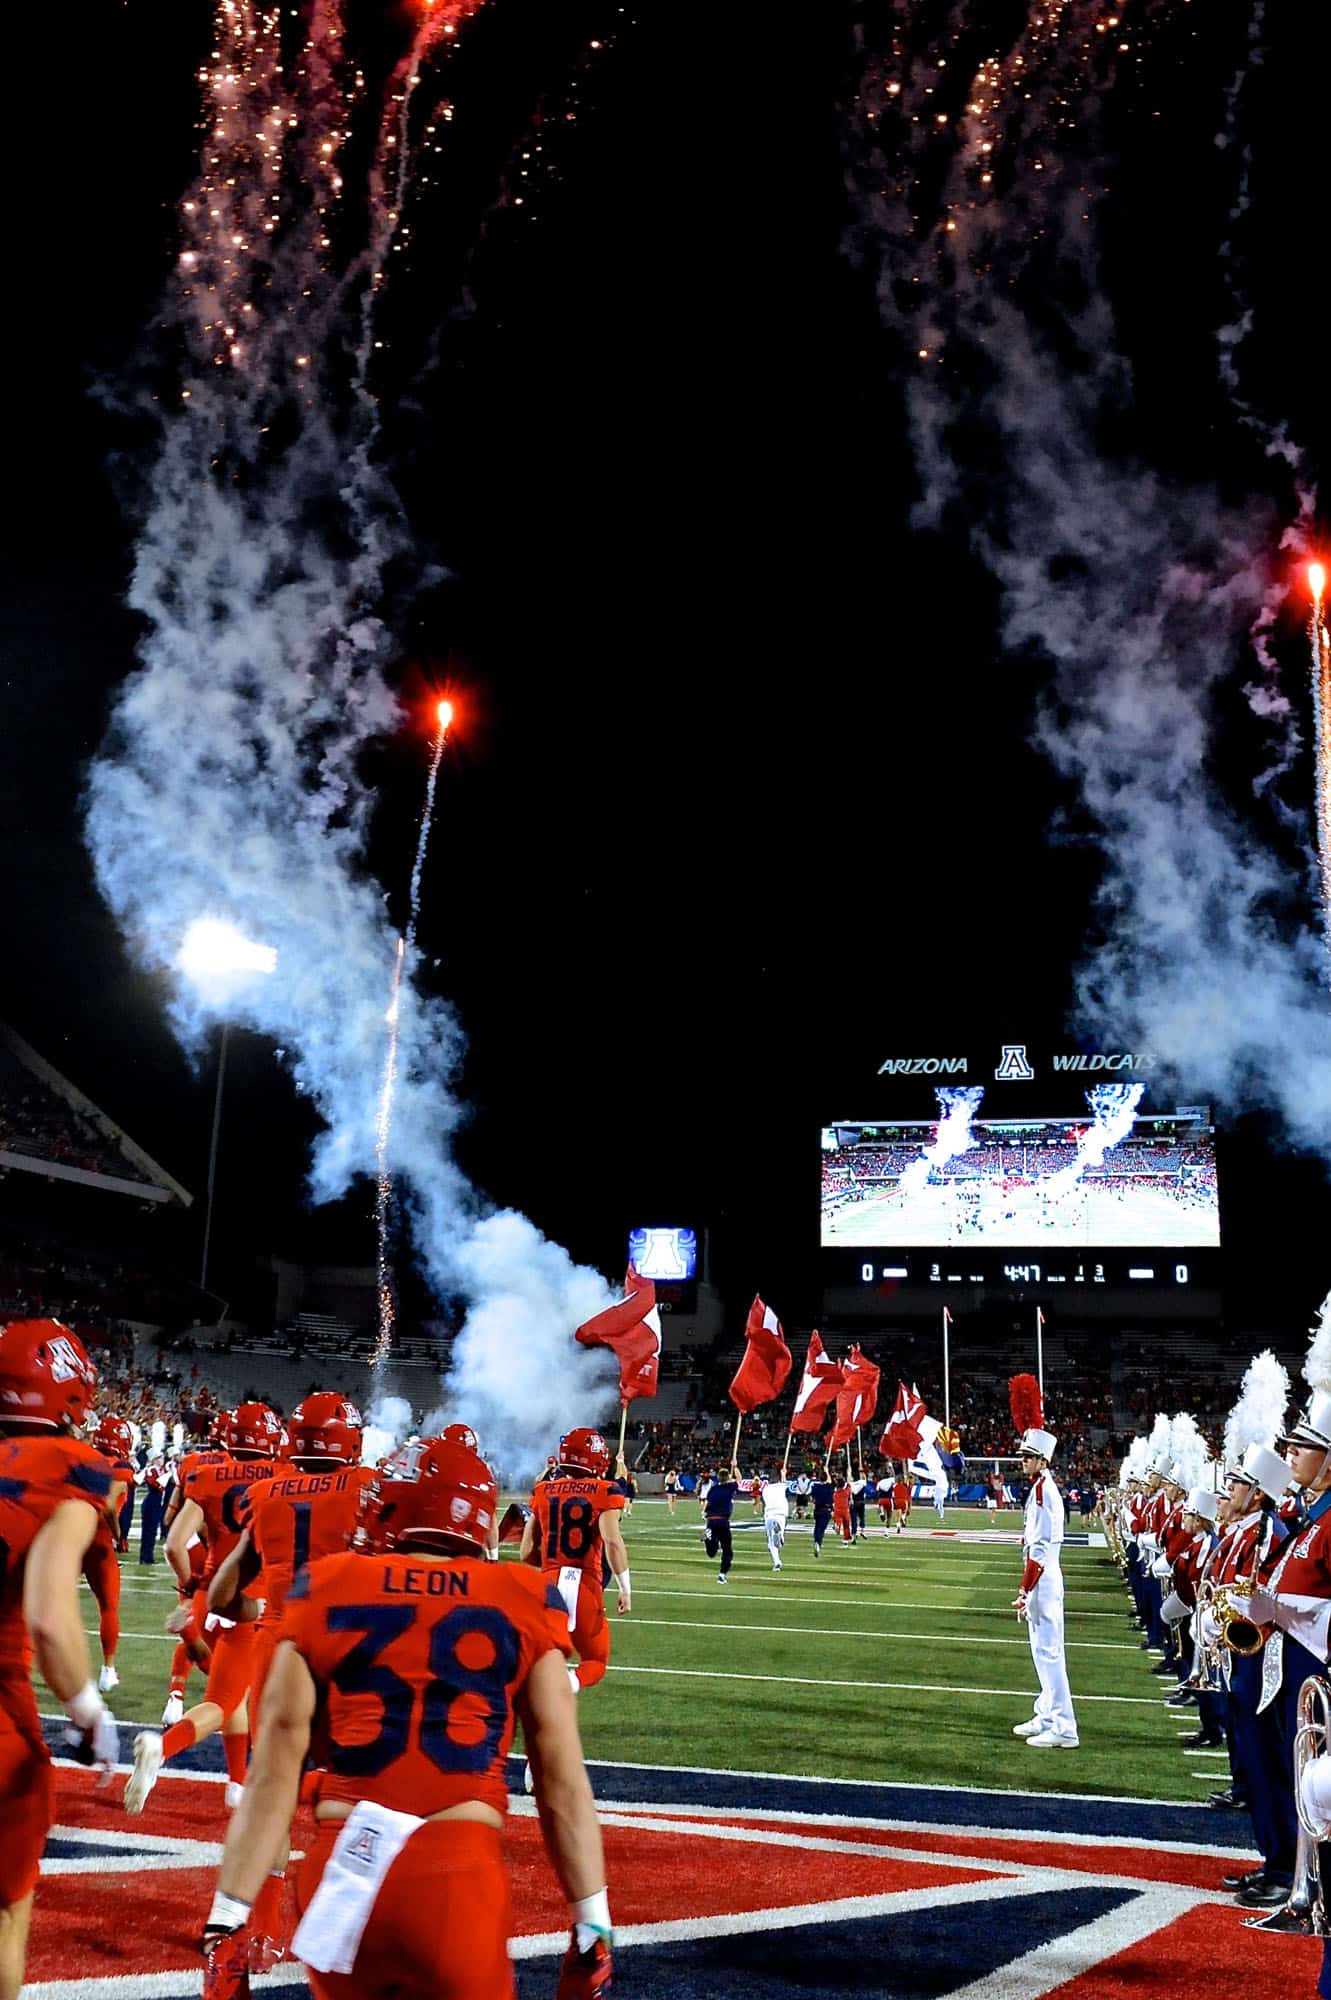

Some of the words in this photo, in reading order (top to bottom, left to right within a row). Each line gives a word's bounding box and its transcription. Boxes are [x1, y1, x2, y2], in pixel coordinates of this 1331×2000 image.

[877, 1057, 968, 1075] ARIZONA
[1052, 1053, 1158, 1071] WILDCATS
[862, 1264, 873, 1281] 0
[1004, 1265, 1041, 1282] 4:47
[1175, 1265, 1188, 1283] 0
[216, 1465, 273, 1482] ELLISON
[270, 1477, 331, 1498] FIELDS
[544, 1482, 599, 1494] PETERSON
[547, 1497, 593, 1559] 18
[291, 1503, 311, 1579] 1
[383, 1567, 469, 1596] LEON
[327, 1604, 521, 1777] 38
